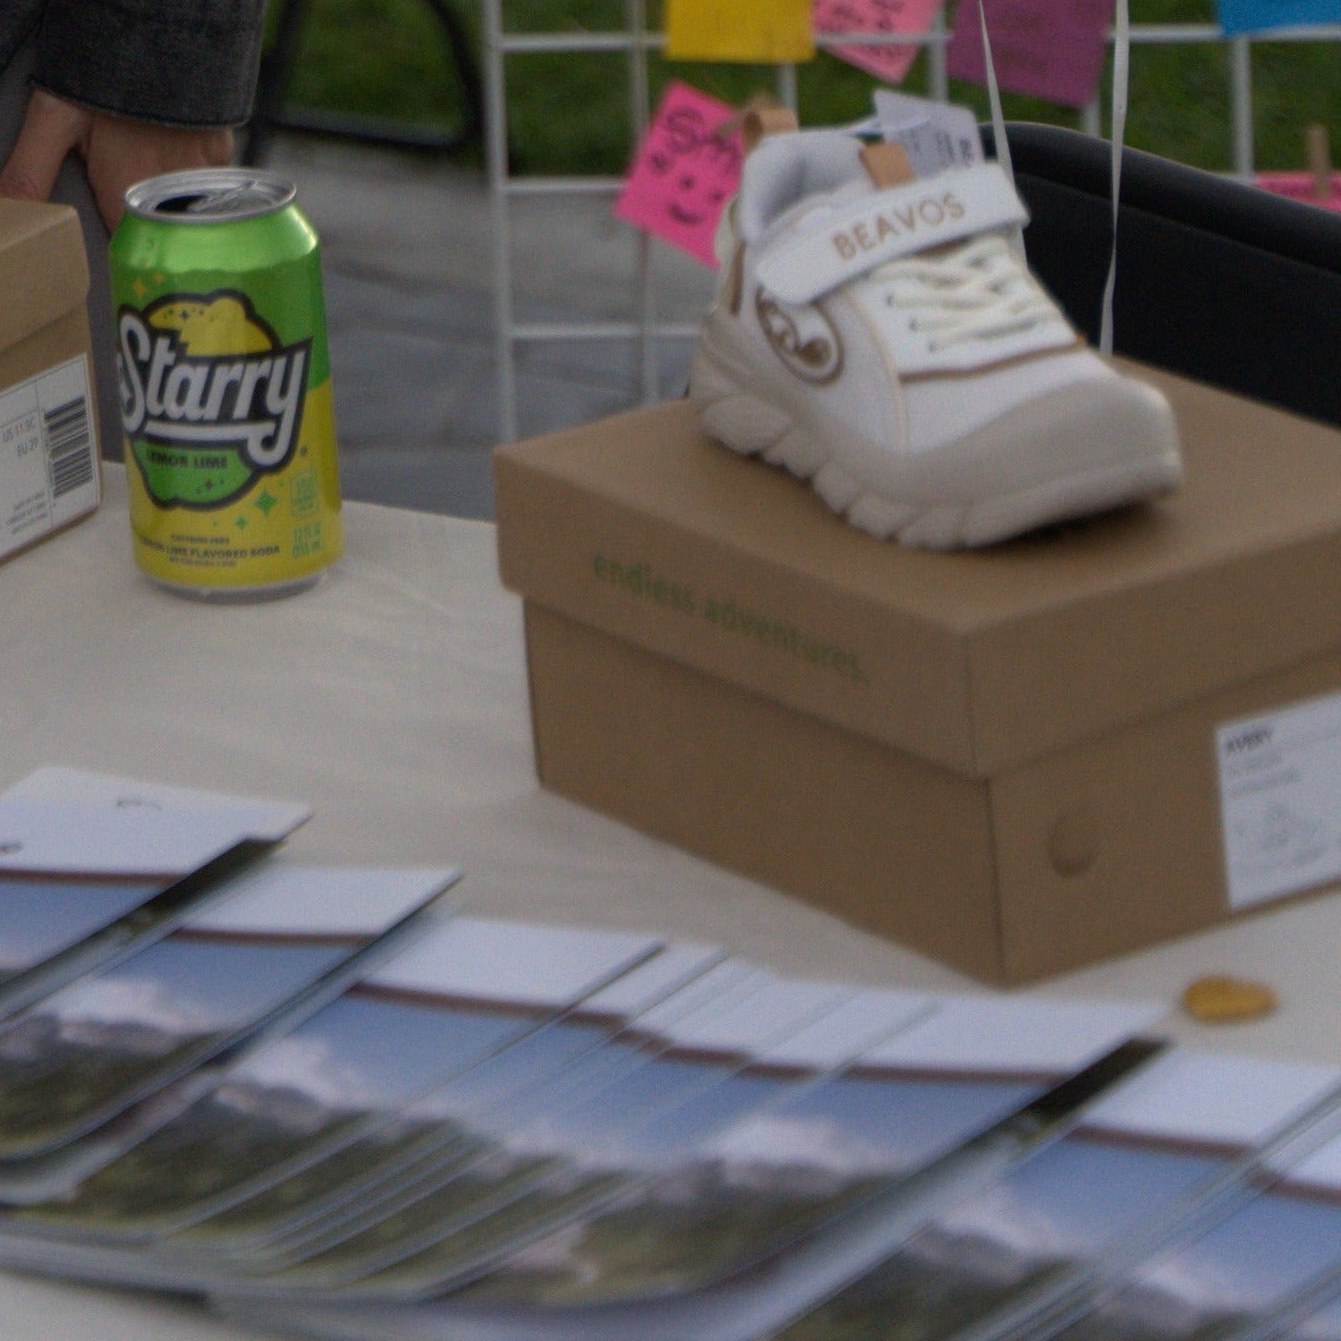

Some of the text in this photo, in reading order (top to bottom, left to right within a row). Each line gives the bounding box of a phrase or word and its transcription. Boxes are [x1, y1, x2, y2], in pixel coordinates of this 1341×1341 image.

[832, 191, 966, 261] BEAVOS
[119, 314, 307, 466] Starry
[147, 449, 228, 468] LEMON LIME
[167, 544, 189, 556] LIME
[189, 547, 247, 559] FLAVORED
[250, 544, 280, 557] SODA
[593, 556, 870, 686] endless adventures.
